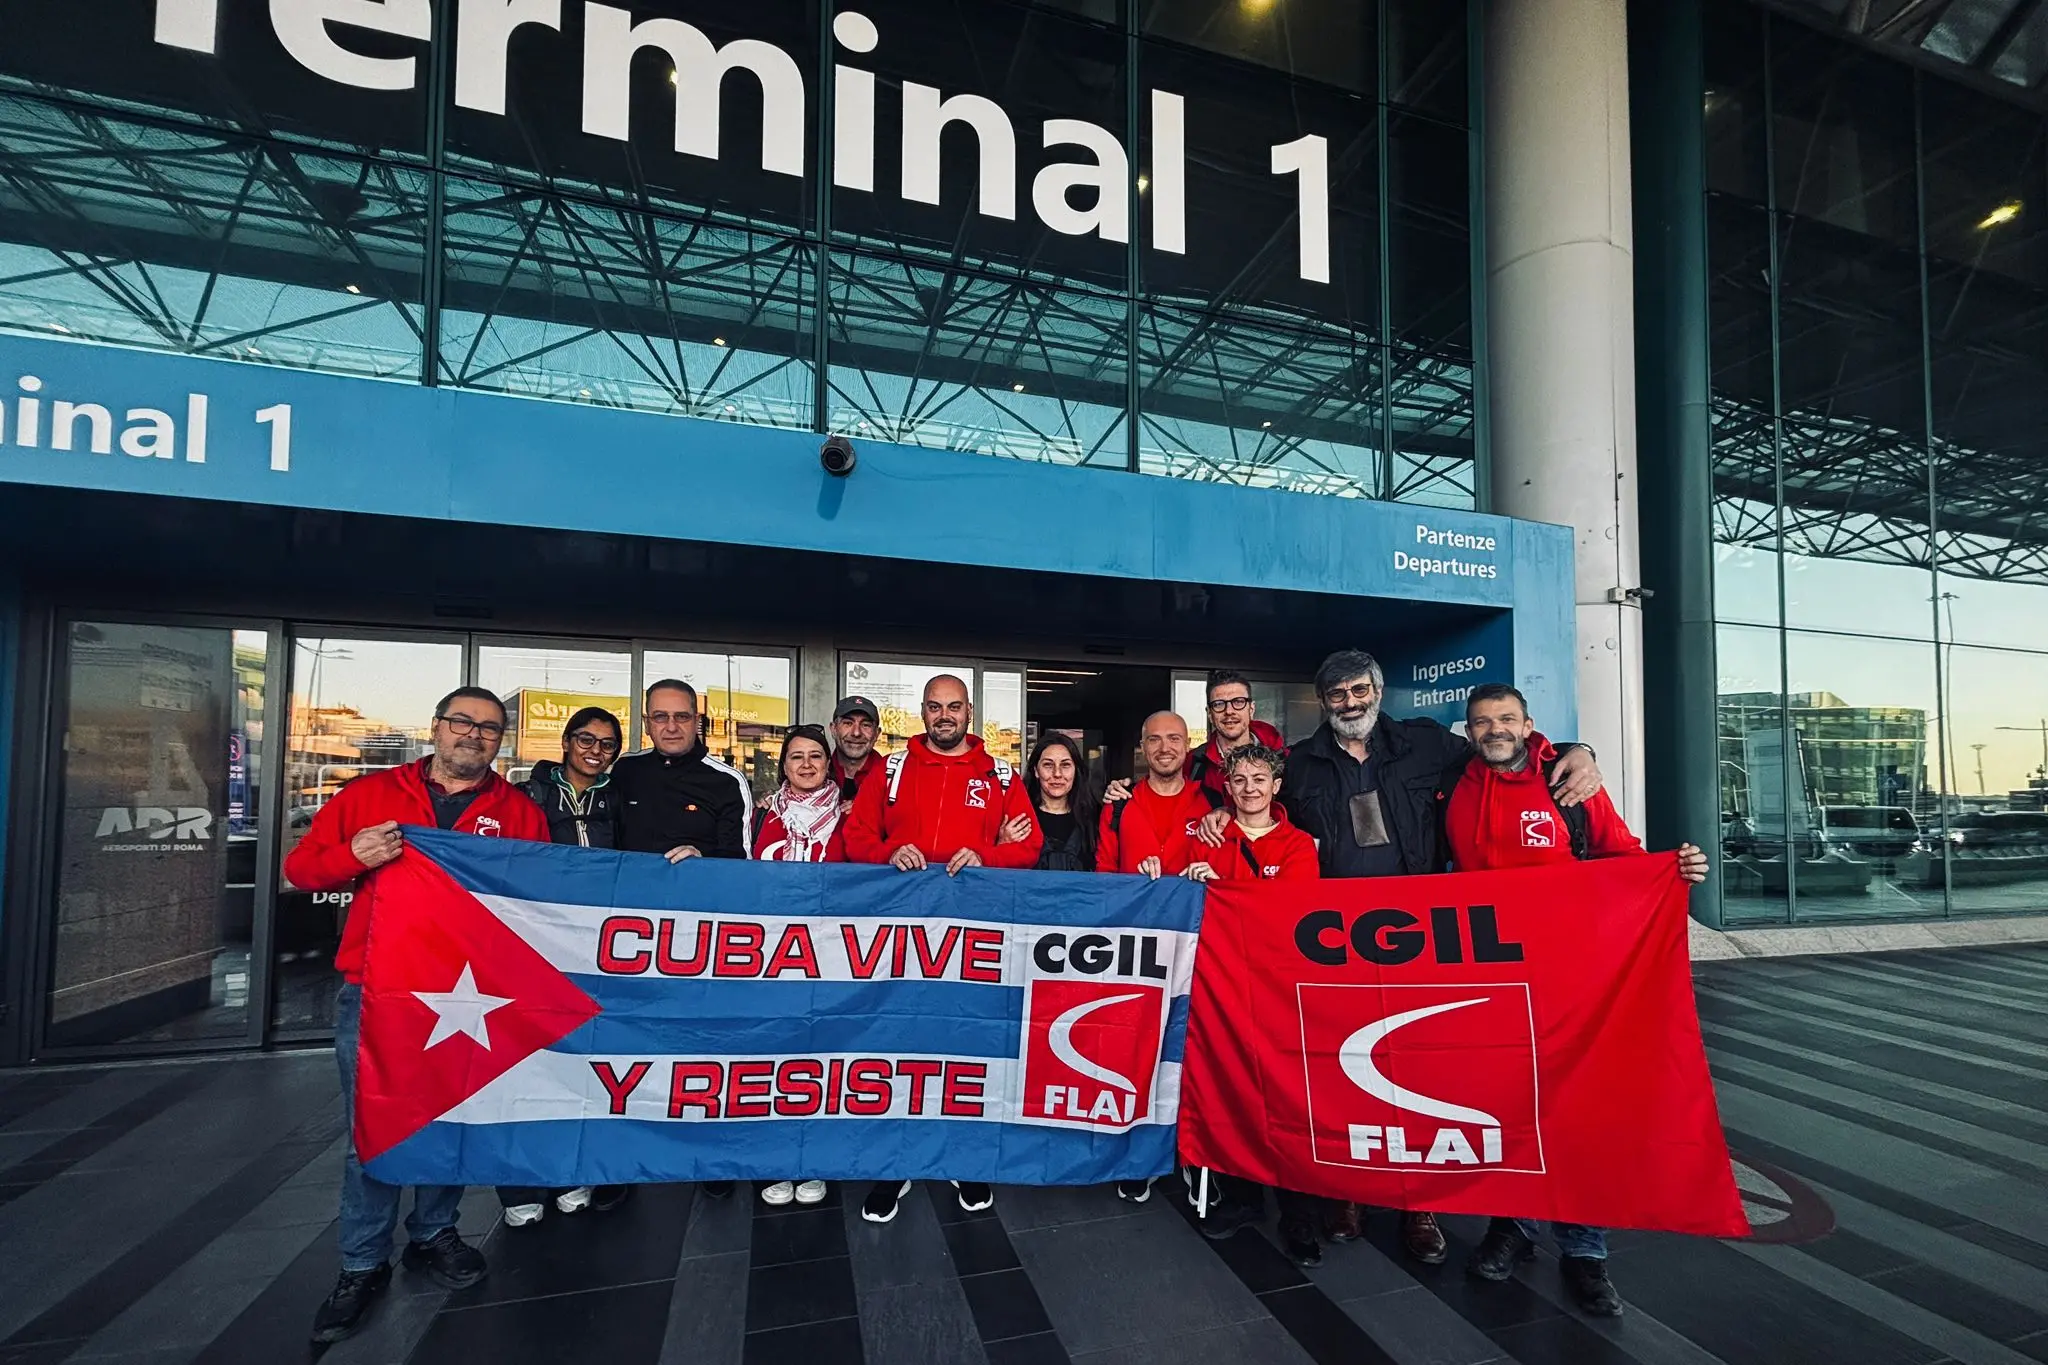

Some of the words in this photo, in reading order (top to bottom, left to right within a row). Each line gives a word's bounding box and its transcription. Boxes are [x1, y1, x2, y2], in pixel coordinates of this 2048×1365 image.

[154, 0, 1186, 255] erminal
[1270, 133, 1331, 284] 1
[0, 375, 208, 464] inal
[255, 403, 292, 472] 1
[1416, 525, 1496, 551] Partenze
[1394, 551, 1497, 579] Departures
[1413, 655, 1486, 684] Ingresso
[1413, 685, 1476, 708] Entranc
[95, 807, 212, 839] ADR
[1520, 810, 1553, 821] CGIL
[102, 844, 158, 852] AEROPORTI
[161, 844, 171, 852] DI
[1527, 838, 1551, 846] FLAI
[312, 892, 354, 908] Dep
[596, 916, 821, 979] CUBA
[840, 923, 1005, 983] VIVE
[1293, 904, 1525, 966] CGIL
[1032, 931, 1168, 980] CGIL
[589, 1060, 655, 1115] Y
[667, 1058, 988, 1118] RESISTE
[1044, 1084, 1137, 1125] FLAI
[1348, 1123, 1504, 1165] FLAI
